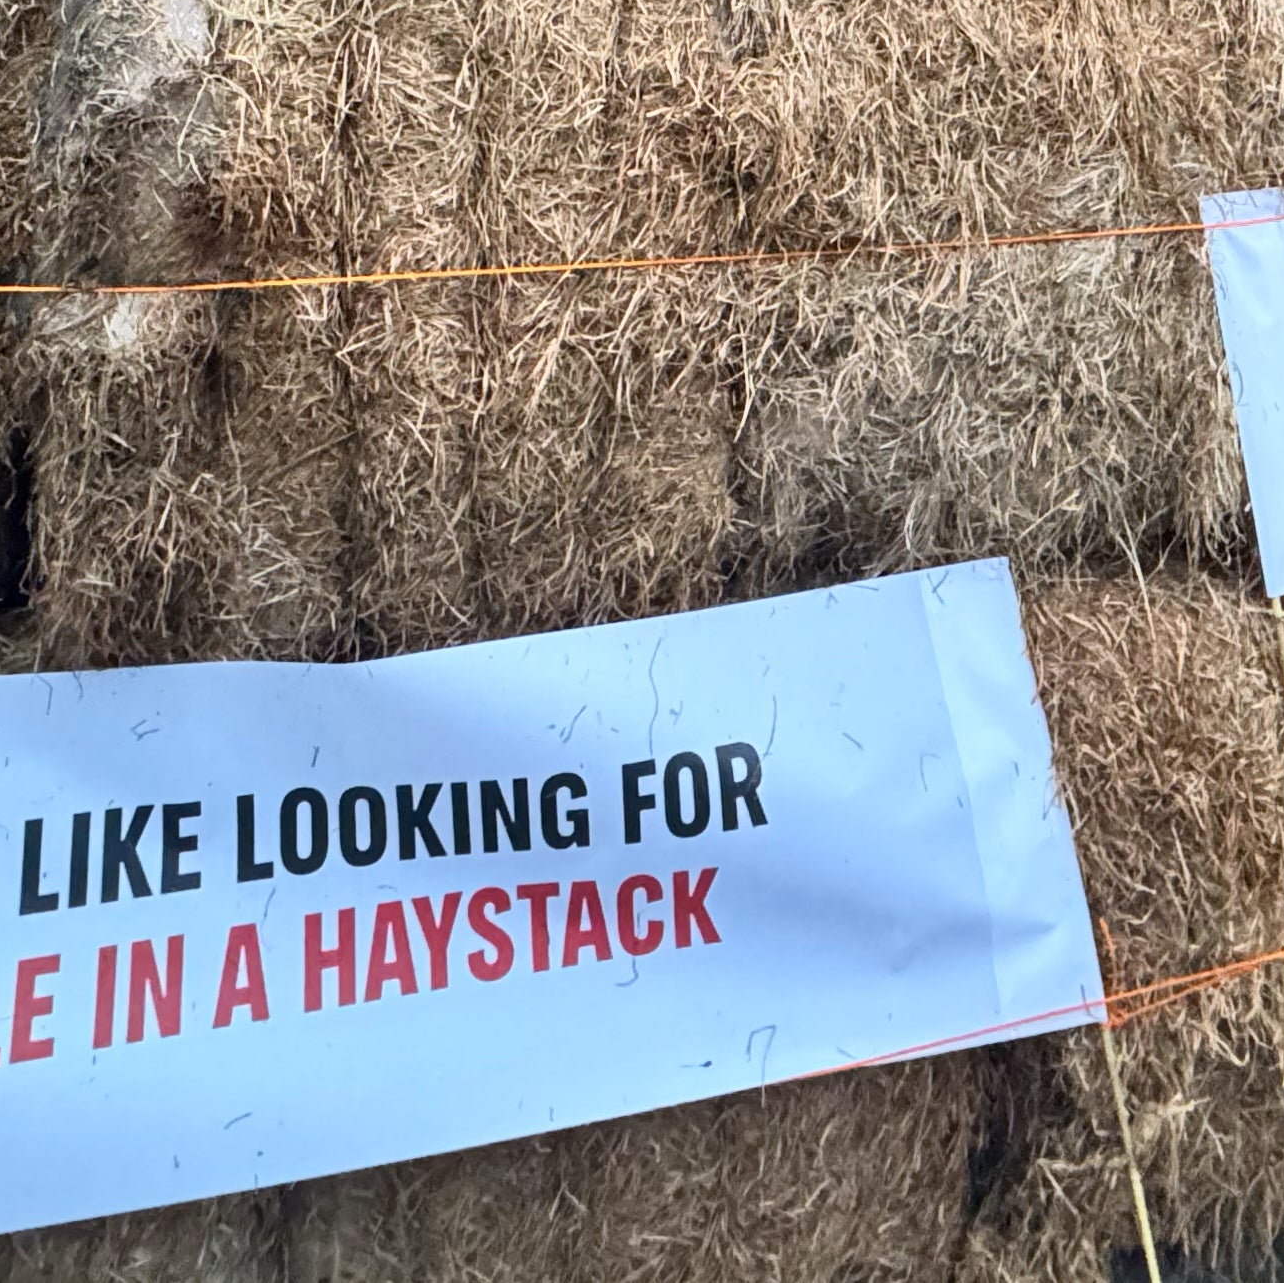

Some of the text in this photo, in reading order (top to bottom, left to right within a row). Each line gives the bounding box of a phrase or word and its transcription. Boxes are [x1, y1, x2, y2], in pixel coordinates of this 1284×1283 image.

[20, 800, 203, 915] LIKE
[236, 772, 591, 883] LOOKING
[622, 743, 769, 844] FOR
[94, 936, 182, 1047] IN
[212, 923, 268, 1025] A
[305, 865, 723, 1010] HAYSTACK
